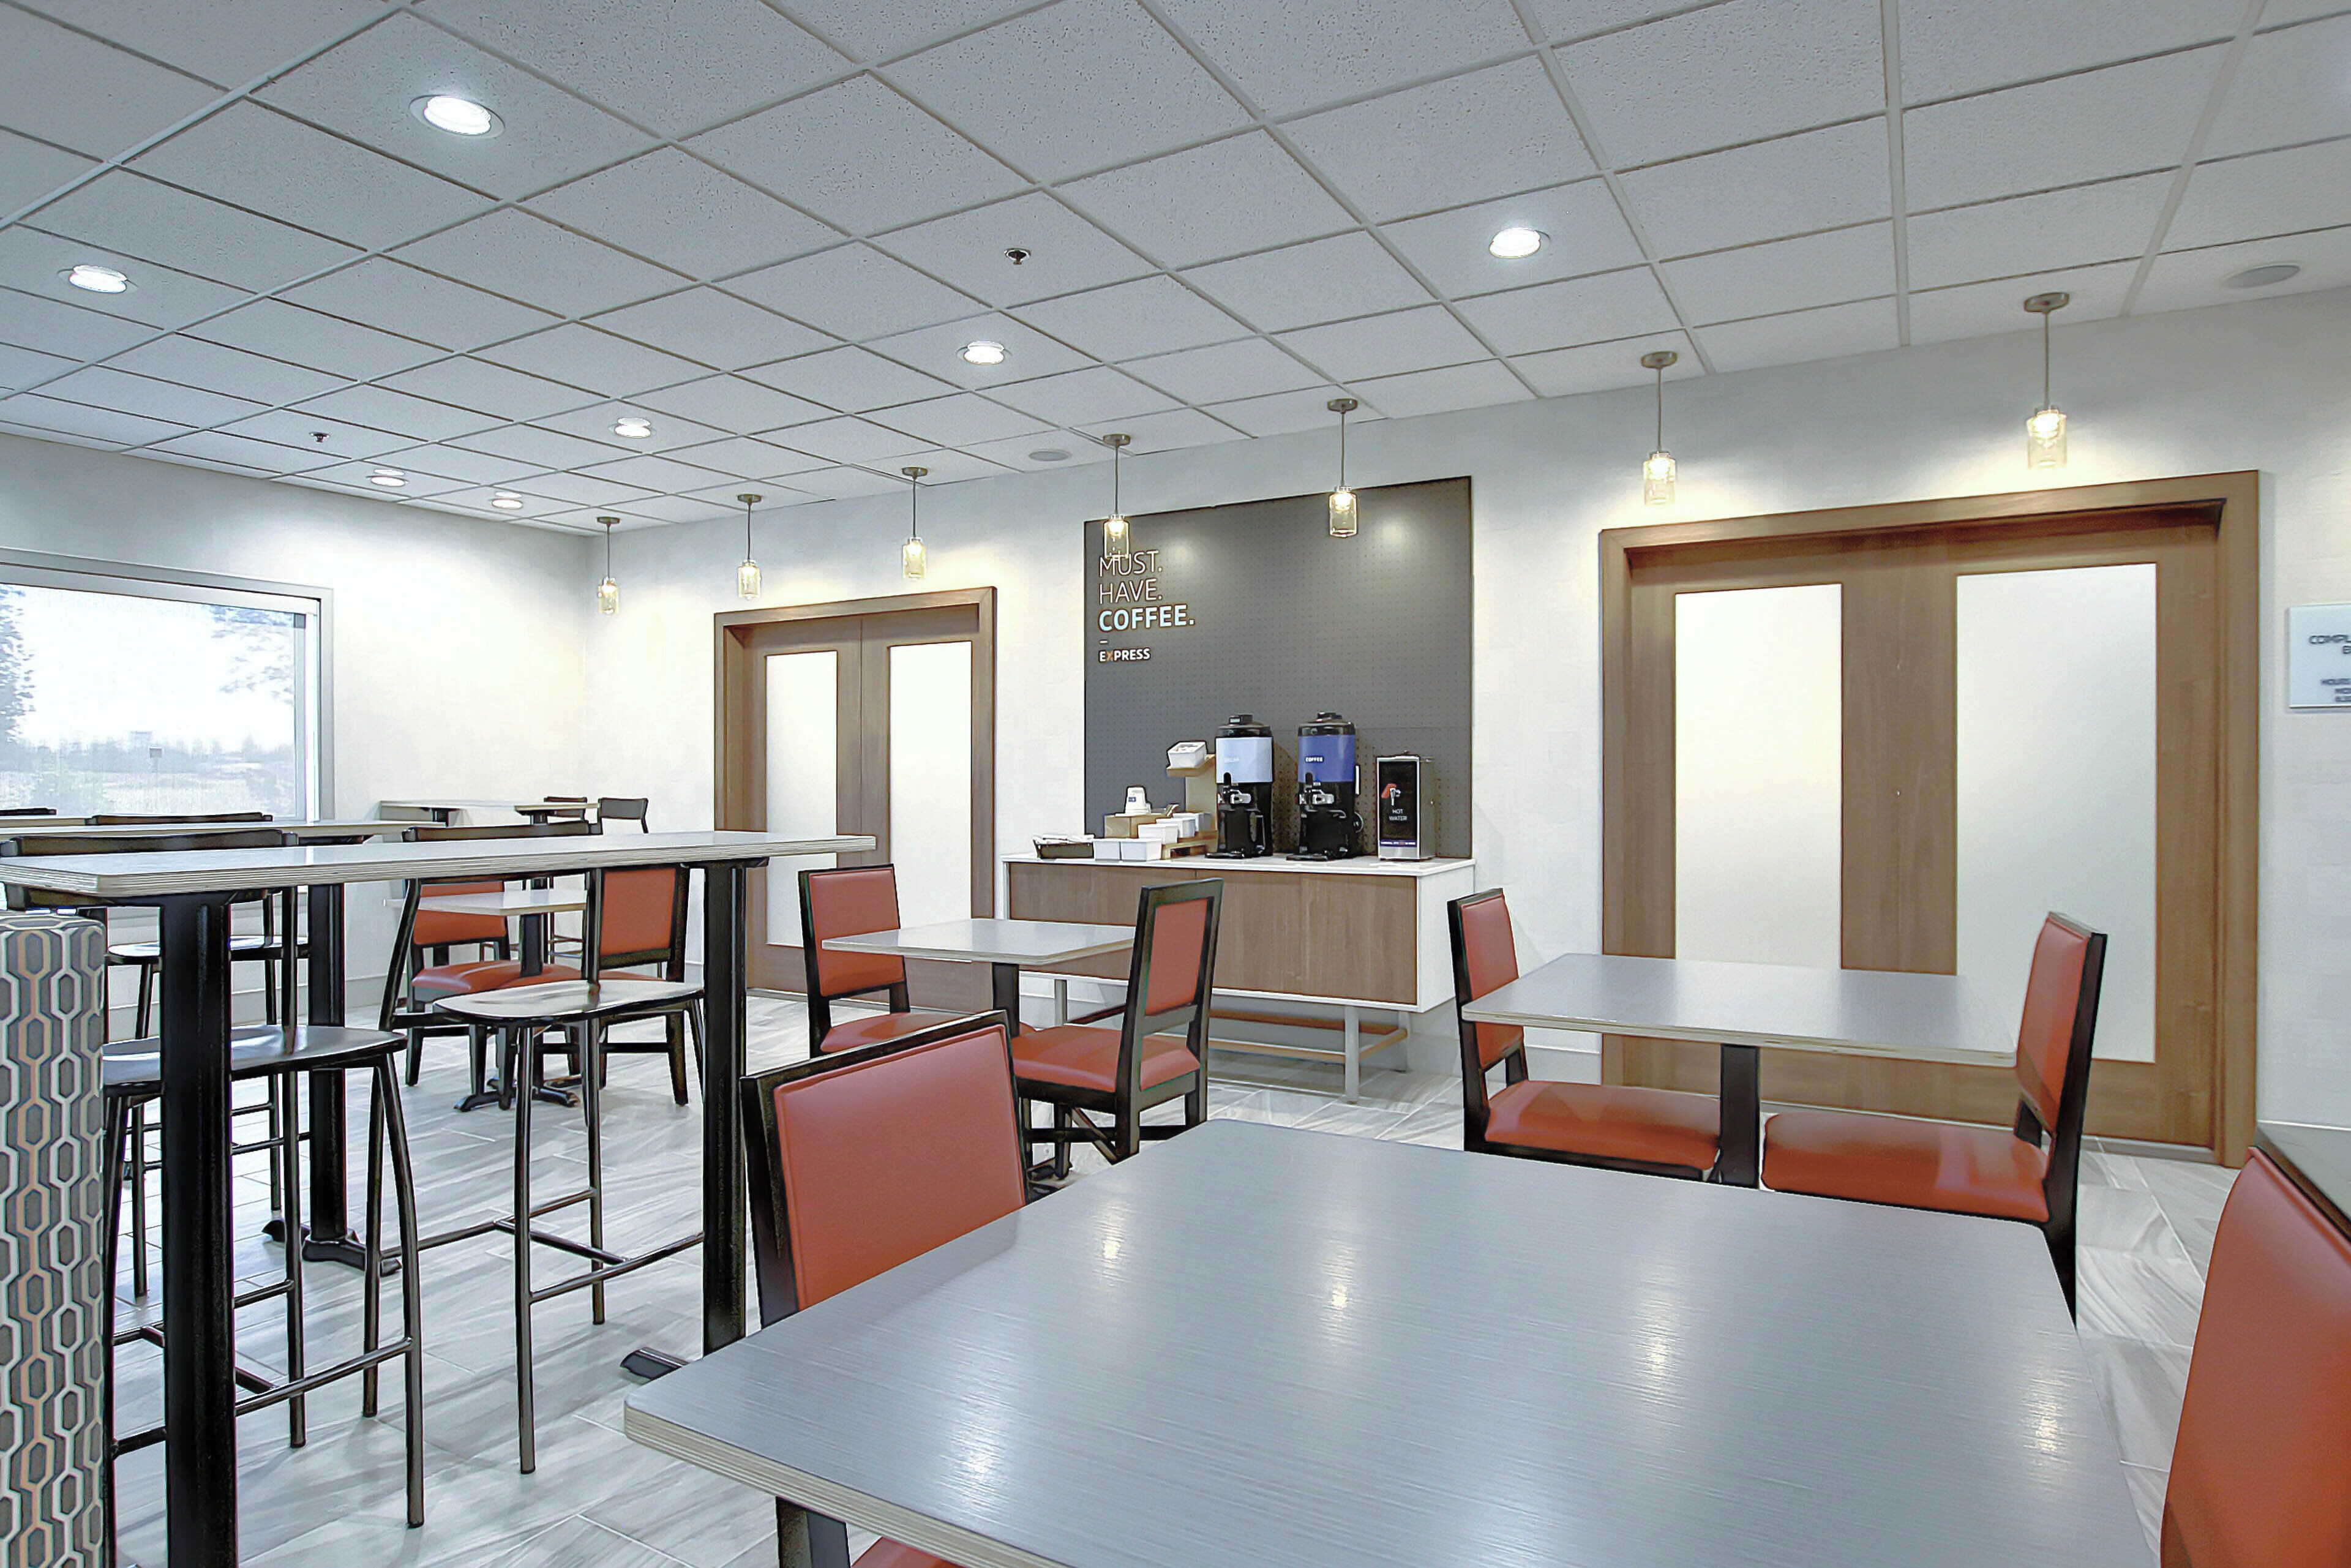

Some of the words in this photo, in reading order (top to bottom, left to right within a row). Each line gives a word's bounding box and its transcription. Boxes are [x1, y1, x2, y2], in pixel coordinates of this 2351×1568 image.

[1099, 550, 1163, 577] MUST.
[1099, 578, 1163, 604] HAVE.
[1099, 604, 1196, 632] COFFEE.
[1099, 648, 1152, 662] EXPRESS
